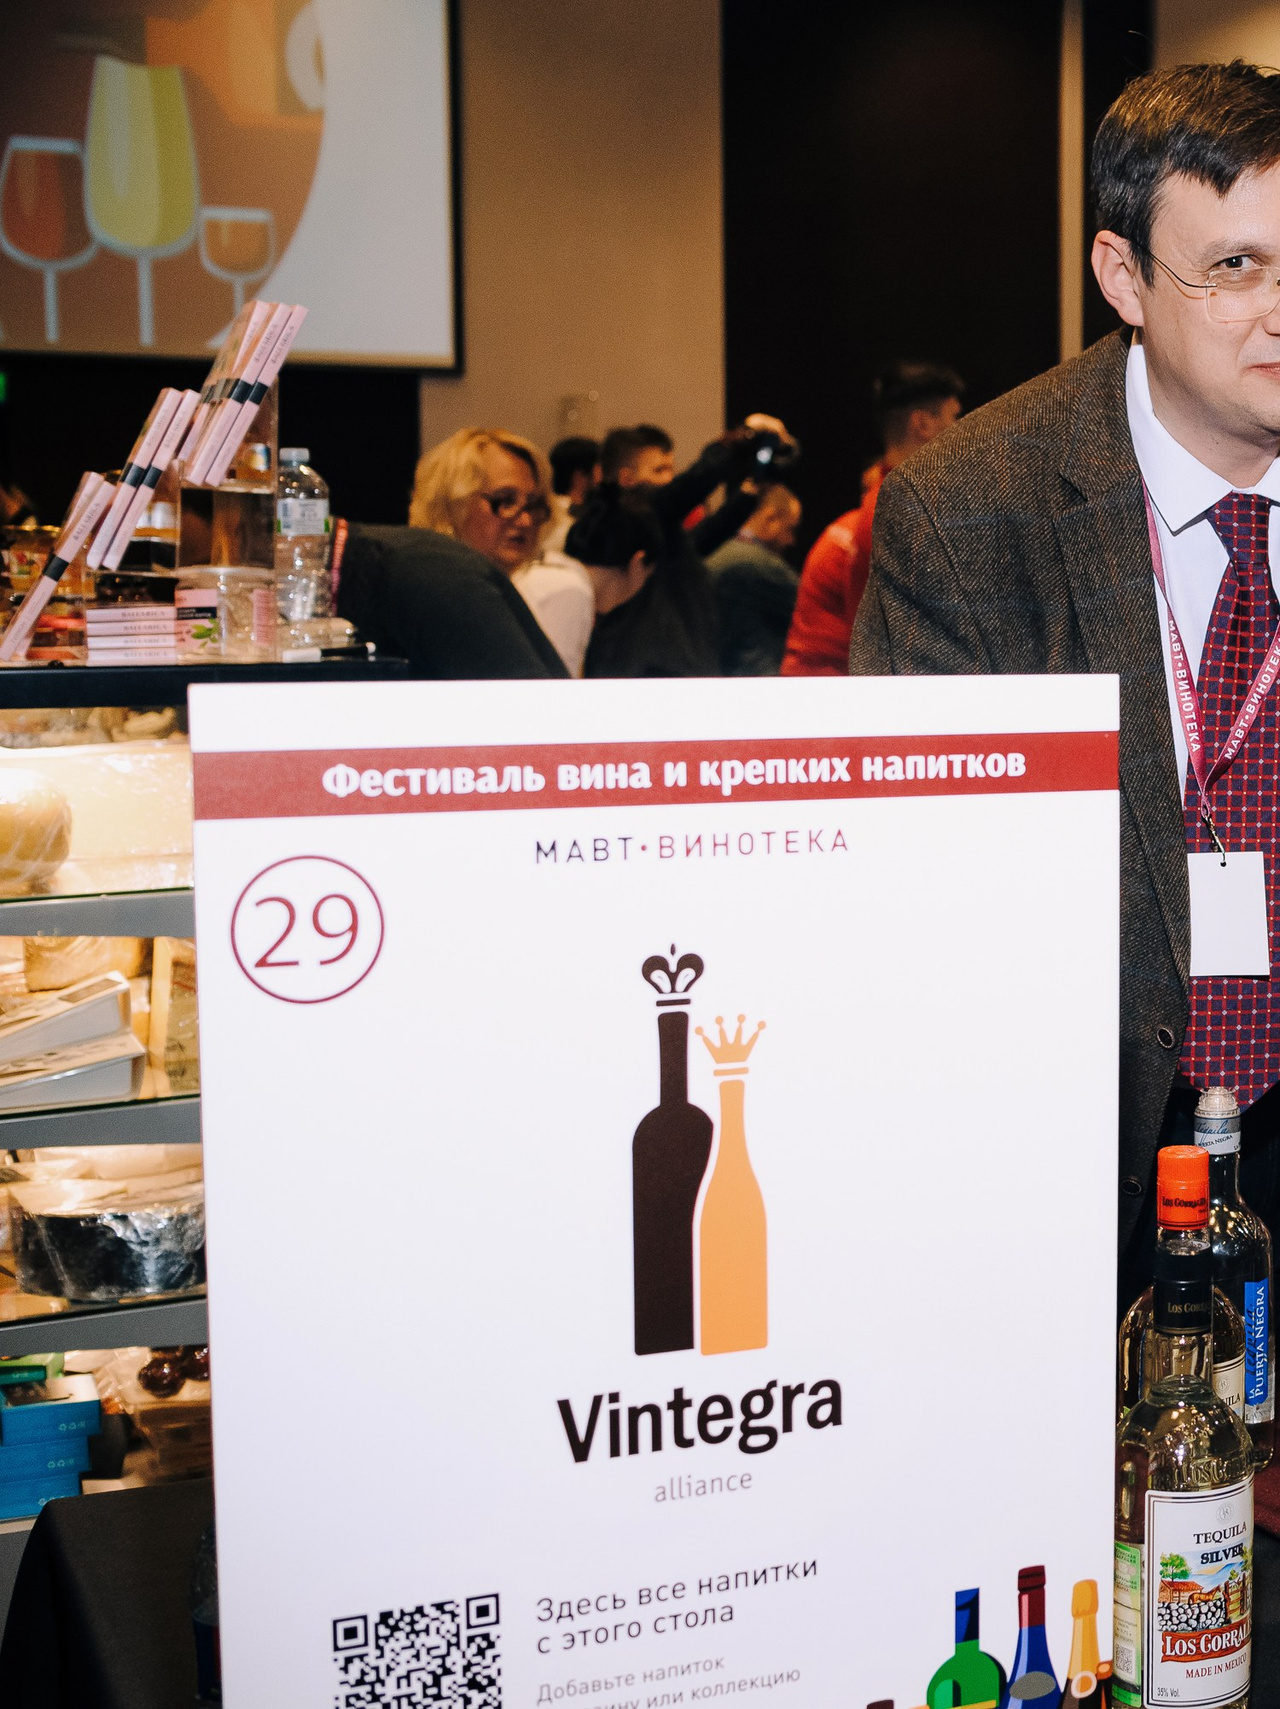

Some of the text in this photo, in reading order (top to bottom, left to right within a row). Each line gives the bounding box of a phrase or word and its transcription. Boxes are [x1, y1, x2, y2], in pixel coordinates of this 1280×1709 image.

[321, 752, 1027, 798] Фестиваль вина и крепких напитков
[253, 894, 360, 970] 29
[1215, 1134, 1234, 1145] NEGRA
[1254, 1286, 1266, 1397] PUERTA NEGRA
[557, 1379, 843, 1463] Vintegra
[654, 1472, 753, 1503] alliance
[1193, 1521, 1247, 1545] TEQUILA
[1200, 1542, 1244, 1565] SILVER
[536, 1559, 818, 1624] Здесь все напитки
[537, 1605, 734, 1654] с этого стола
[536, 1657, 725, 1706] Добавьте напиток
[1186, 1653, 1247, 1679] MADE IN MEXICO
[646, 1691, 684, 1709] или
[691, 1668, 801, 1701] коллекцию
[1157, 1687, 1168, 1697] 35%
